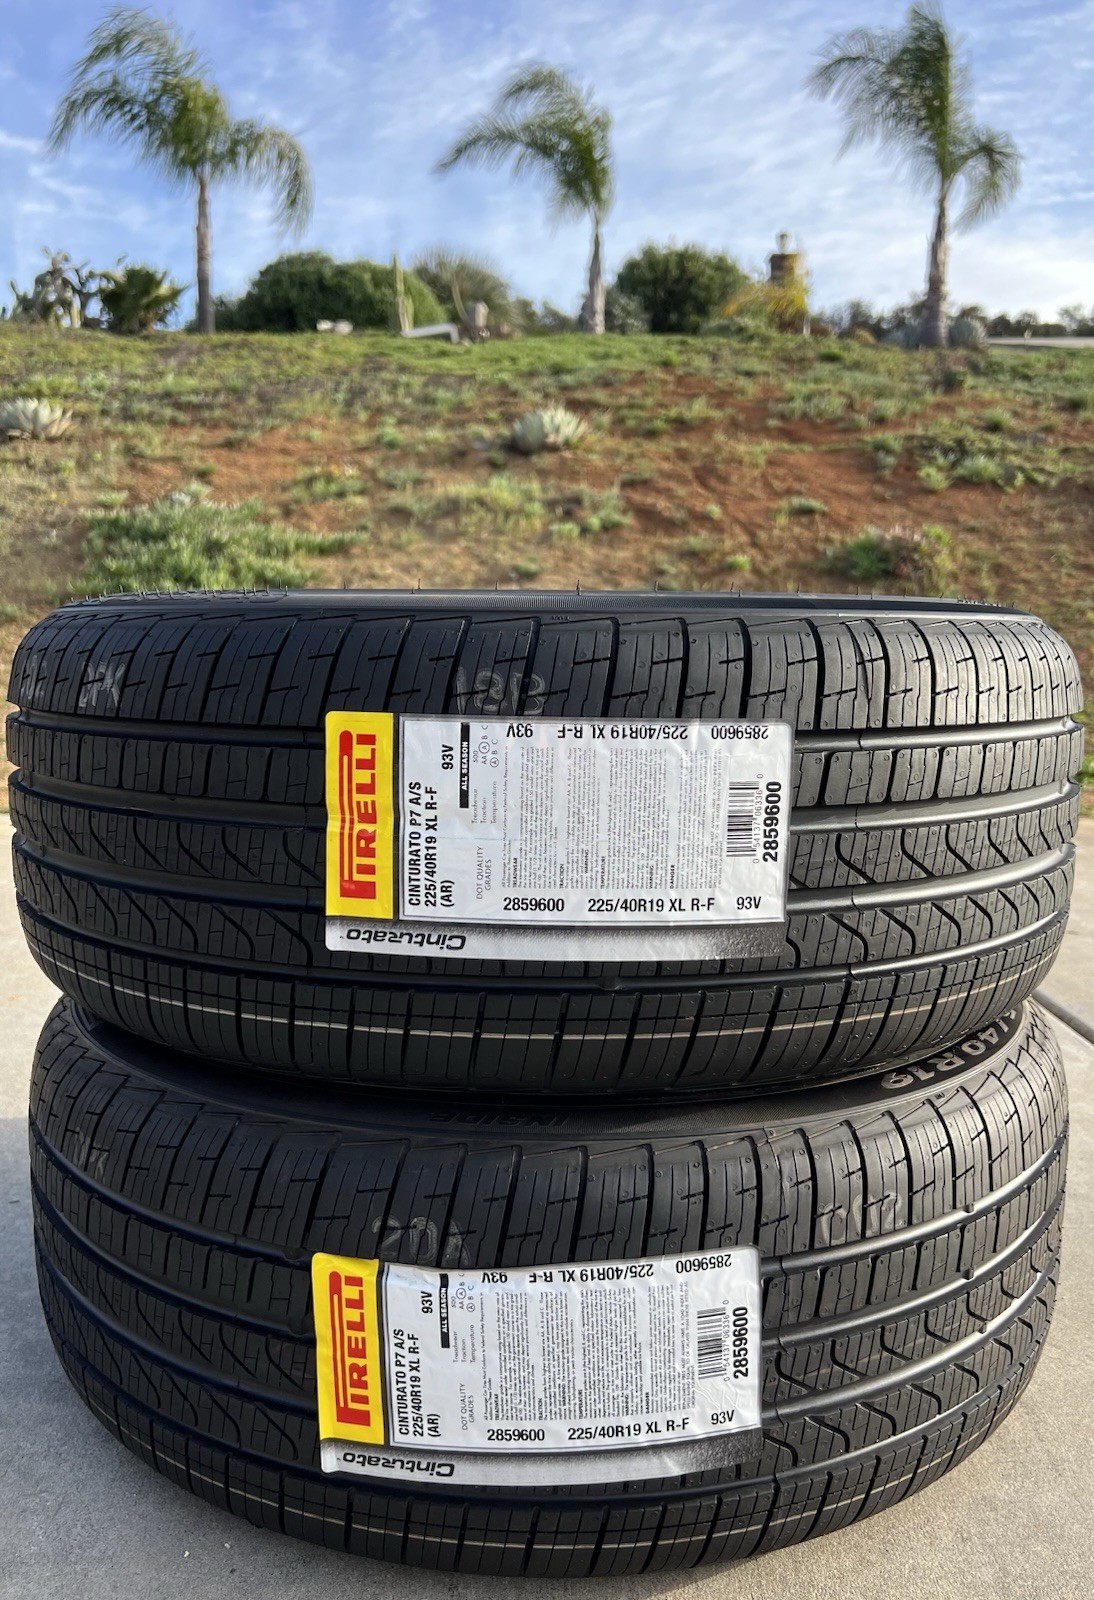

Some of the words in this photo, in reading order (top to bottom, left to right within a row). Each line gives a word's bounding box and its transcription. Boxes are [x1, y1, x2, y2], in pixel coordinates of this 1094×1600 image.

[506, 723, 533, 738] 93V
[557, 724, 583, 739] R-F
[590, 724, 606, 739] XL
[610, 724, 688, 740] 225/40R19
[711, 725, 769, 740] 2859600
[441, 744, 454, 770] 93V
[481, 755, 487, 765] AA
[409, 782, 422, 806] A/S
[425, 786, 437, 810] R-F
[339, 730, 376, 899] PIRELLI
[410, 810, 422, 826] P7
[425, 815, 437, 831] XL
[762, 781, 781, 862] 2859600
[409, 831, 422, 906] CINTURATO
[425, 836, 437, 907] 225/40R19
[440, 880, 454, 908] (AR)
[503, 897, 565, 913] 2859600
[588, 897, 664, 913] 225/40R19
[669, 897, 686, 912] XL
[691, 897, 715, 912] R-F
[736, 896, 762, 909] 93V
[346, 929, 466, 951] Cinturato
[580, 1263, 654, 1282] 225/40R19
[676, 1254, 732, 1274] 2859600
[481, 1271, 508, 1284] 93V
[529, 1271, 553, 1284] R-F
[558, 1269, 575, 1283] XL
[421, 1291, 432, 1314] 93V
[458, 1301, 464, 1310] AA
[329, 1271, 370, 1426] PIRELLI
[394, 1328, 405, 1349] A/S
[408, 1333, 419, 1354] R-F
[733, 1306, 748, 1379] 2859600
[395, 1353, 406, 1367] P7
[409, 1358, 420, 1372] XL
[395, 1371, 409, 1435] CINTURATO
[410, 1376, 424, 1437] 225/40R19
[427, 1413, 441, 1437] (AR)
[487, 1428, 545, 1442] 2859600
[567, 1422, 642, 1441] 225/40R19
[645, 1420, 662, 1434] XL
[666, 1418, 690, 1433] R-F
[711, 1409, 735, 1425] 93V
[343, 1452, 455, 1477] Cinturato
